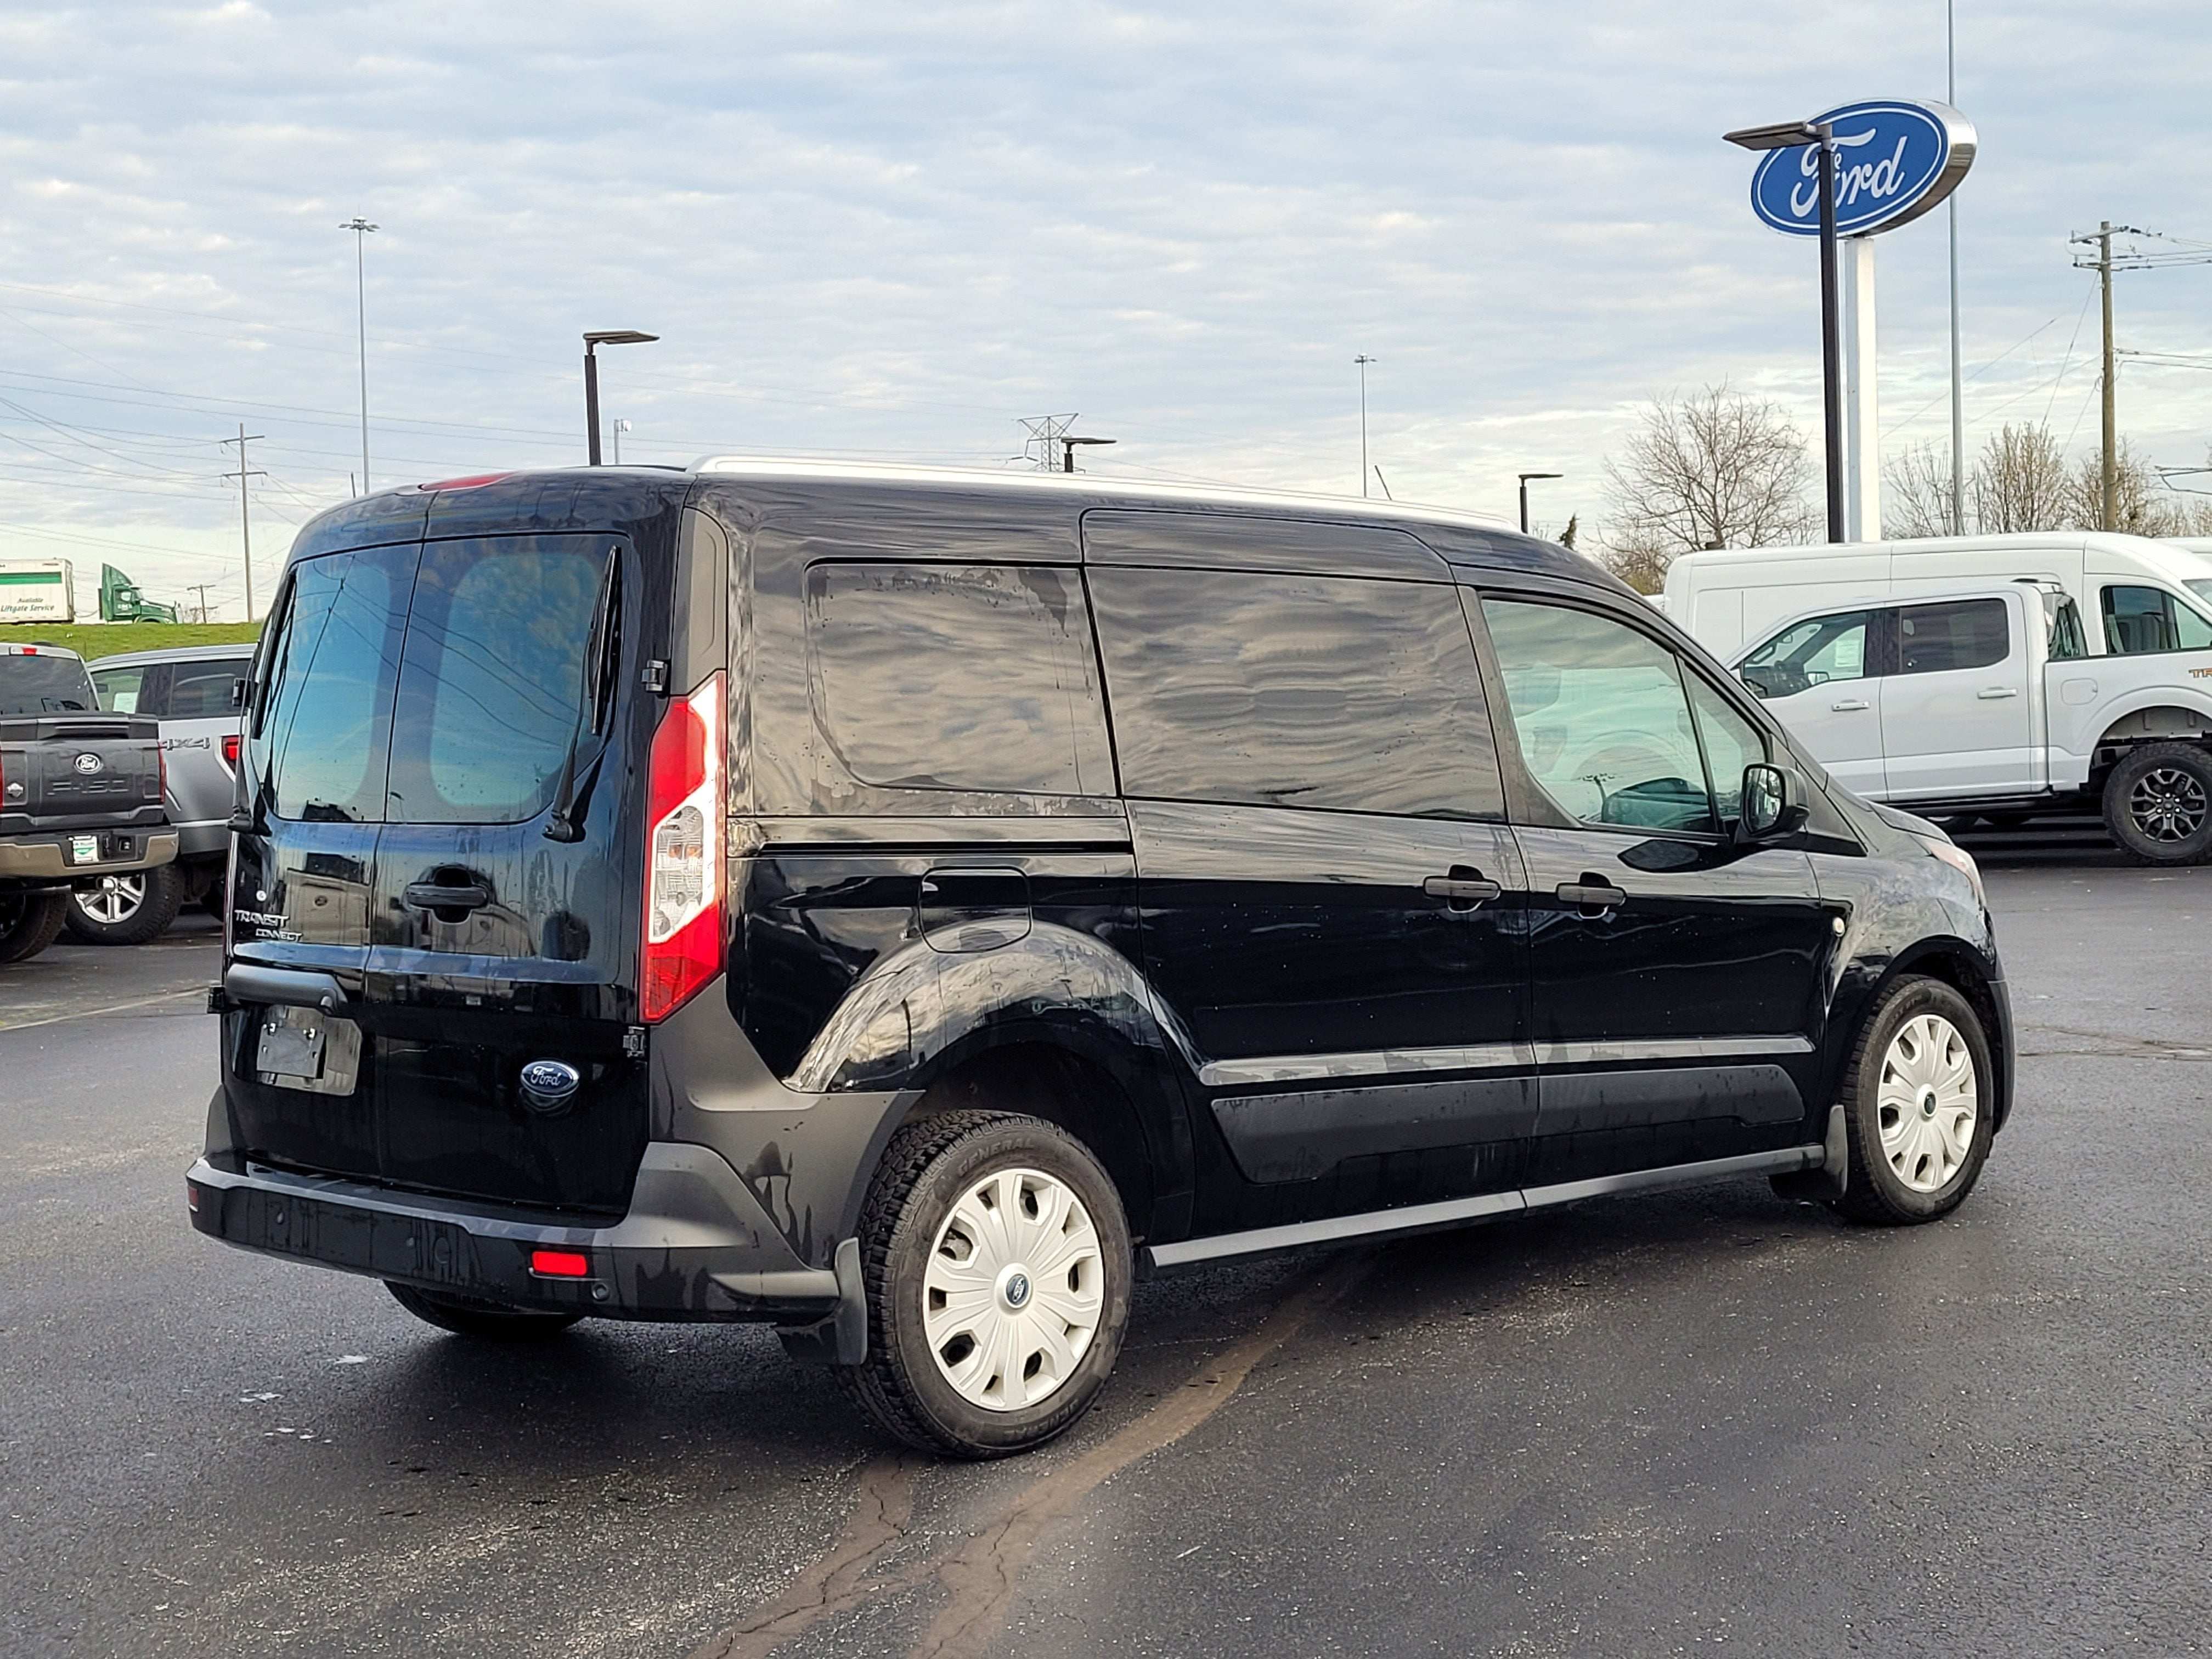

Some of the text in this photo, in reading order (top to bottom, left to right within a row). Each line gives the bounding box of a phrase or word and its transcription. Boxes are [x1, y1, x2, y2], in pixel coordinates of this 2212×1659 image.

[234, 909, 290, 927] TRANSIT
[255, 928, 303, 942] CONNECT
[531, 1065, 562, 1086] Ford
[958, 1138, 1035, 1177] GENERAL
